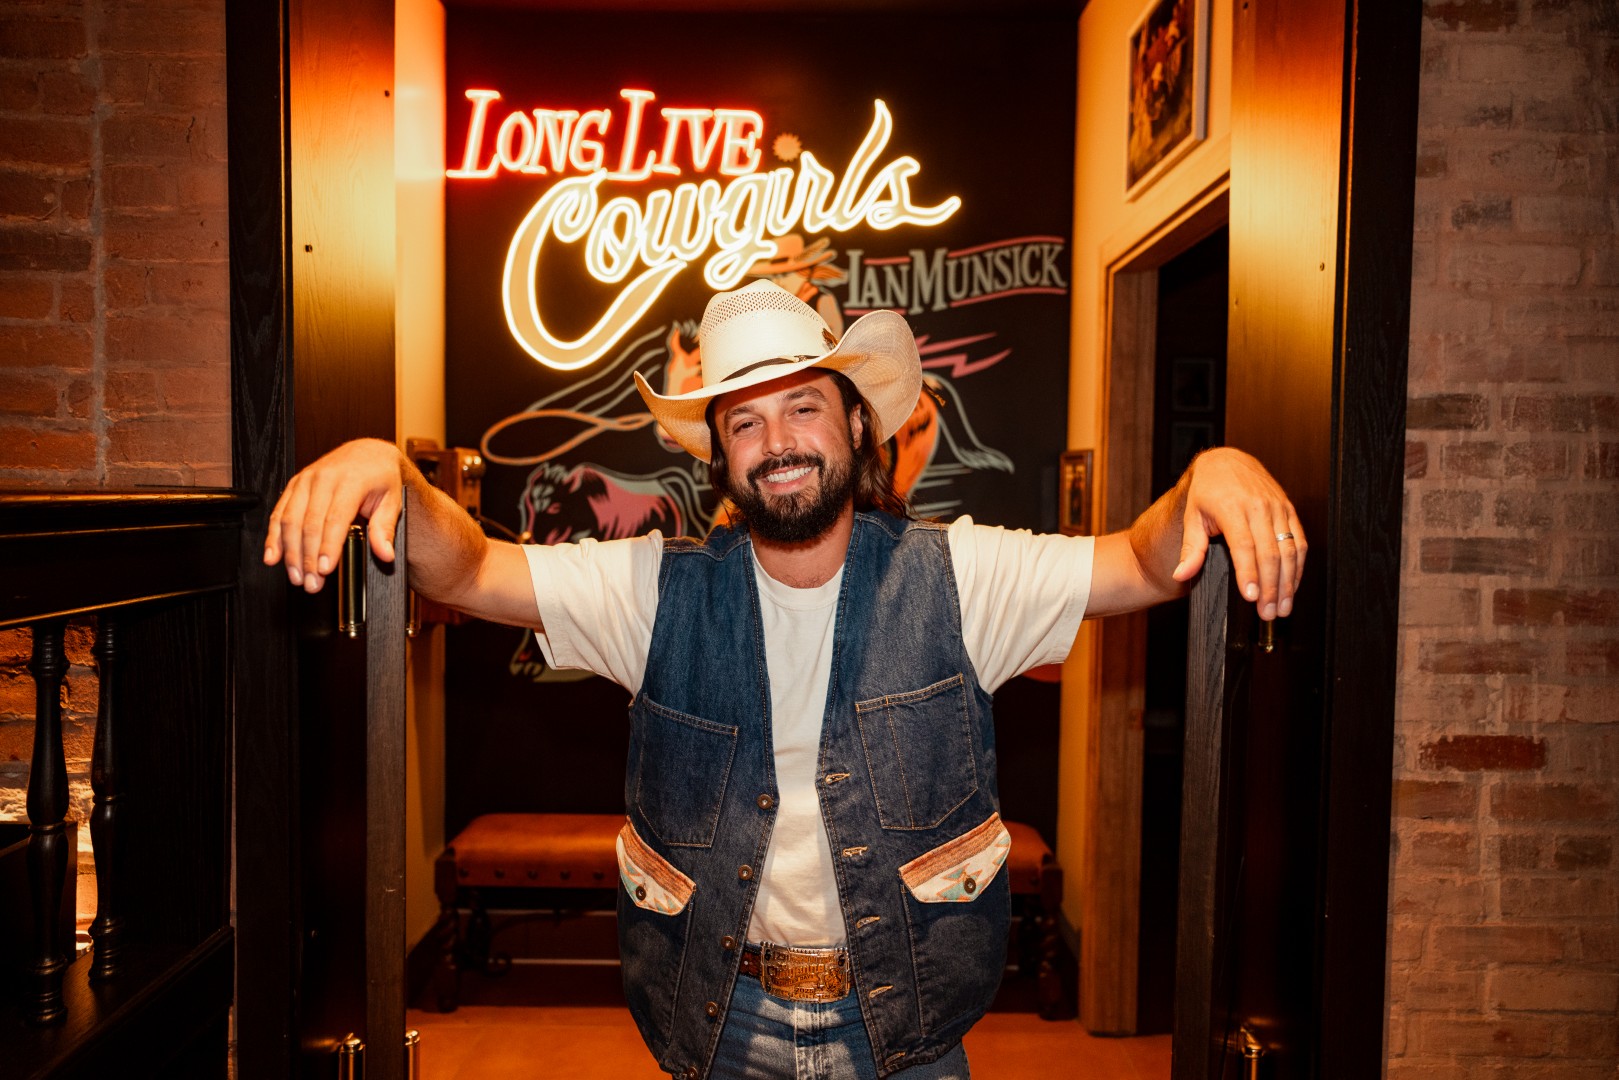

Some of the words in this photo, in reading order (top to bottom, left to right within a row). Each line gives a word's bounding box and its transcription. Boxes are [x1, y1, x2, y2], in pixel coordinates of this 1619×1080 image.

[445, 88, 612, 179] LONG
[603, 88, 764, 181] LIVE
[502, 98, 962, 371] Cowgirls
[843, 249, 909, 309] IAN
[908, 245, 1068, 315] MUNSICK
